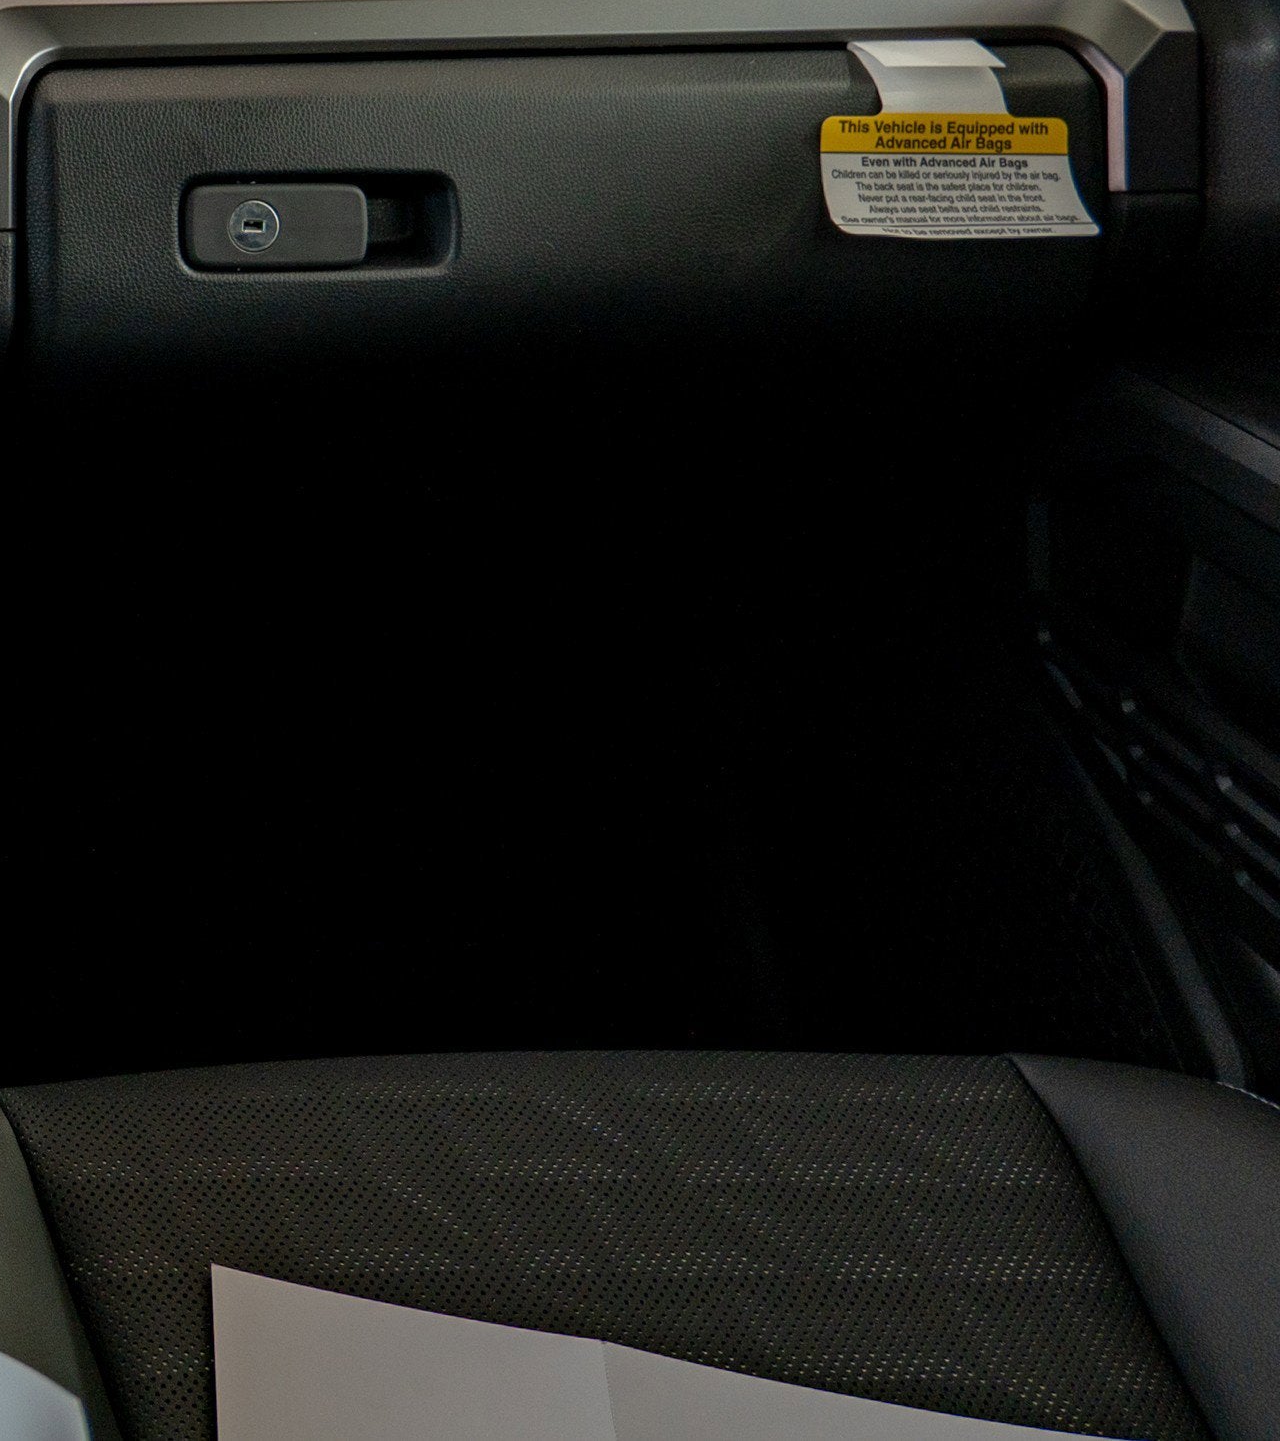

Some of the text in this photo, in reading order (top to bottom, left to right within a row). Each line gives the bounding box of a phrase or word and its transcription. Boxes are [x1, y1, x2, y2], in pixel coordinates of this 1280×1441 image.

[838, 121, 1049, 136] This Vehicle is Equipped with
[875, 136, 1012, 152] Advanced Air Bags
[861, 157, 1029, 170] Even with Advanced Air Bags
